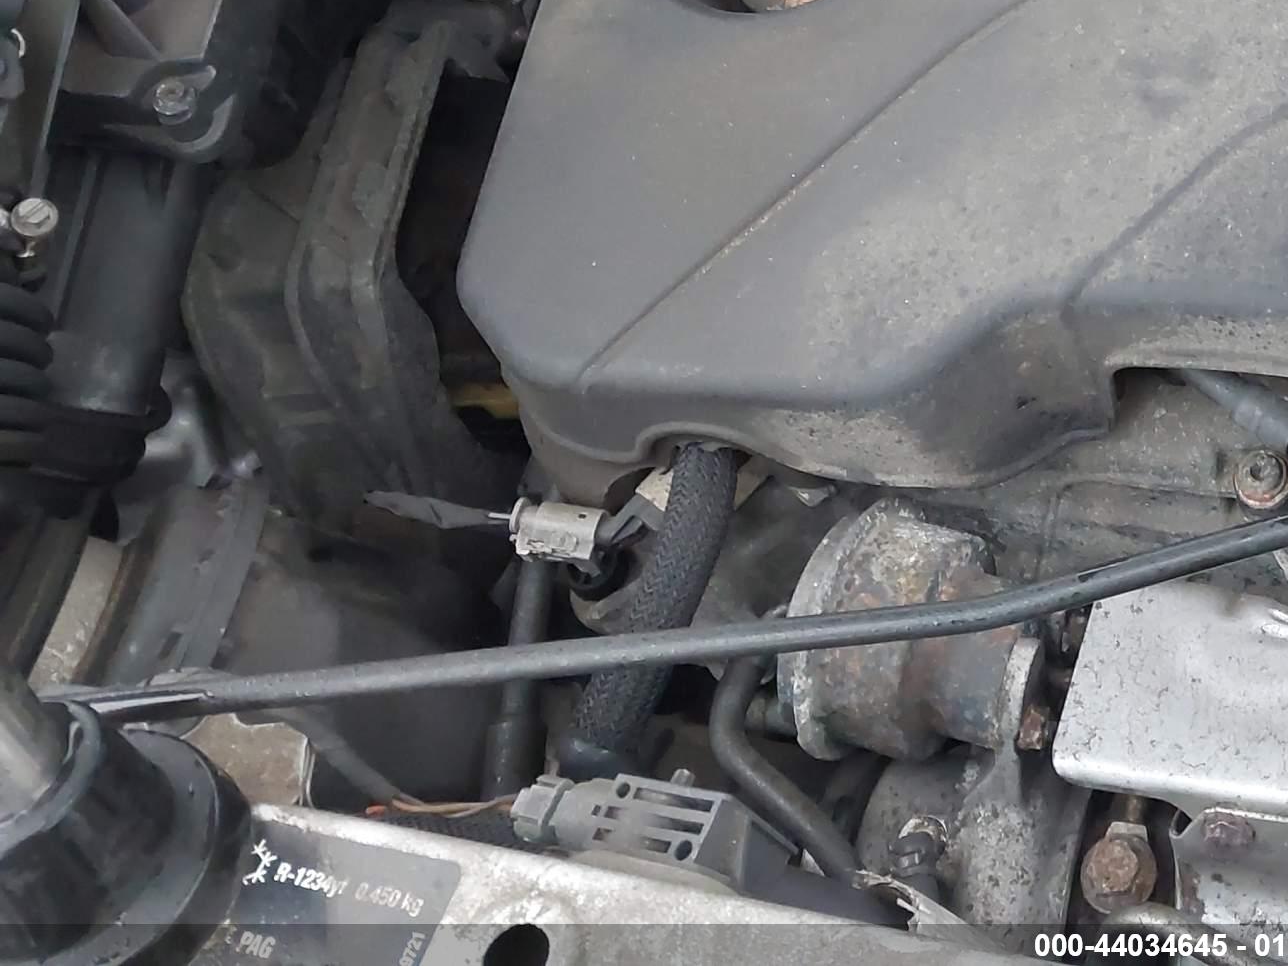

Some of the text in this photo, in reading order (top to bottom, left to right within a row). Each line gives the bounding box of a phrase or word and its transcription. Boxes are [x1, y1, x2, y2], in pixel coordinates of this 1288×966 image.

[354, 881, 402, 908] 0.450
[400, 891, 425, 918] kg
[236, 930, 276, 959] PAG
